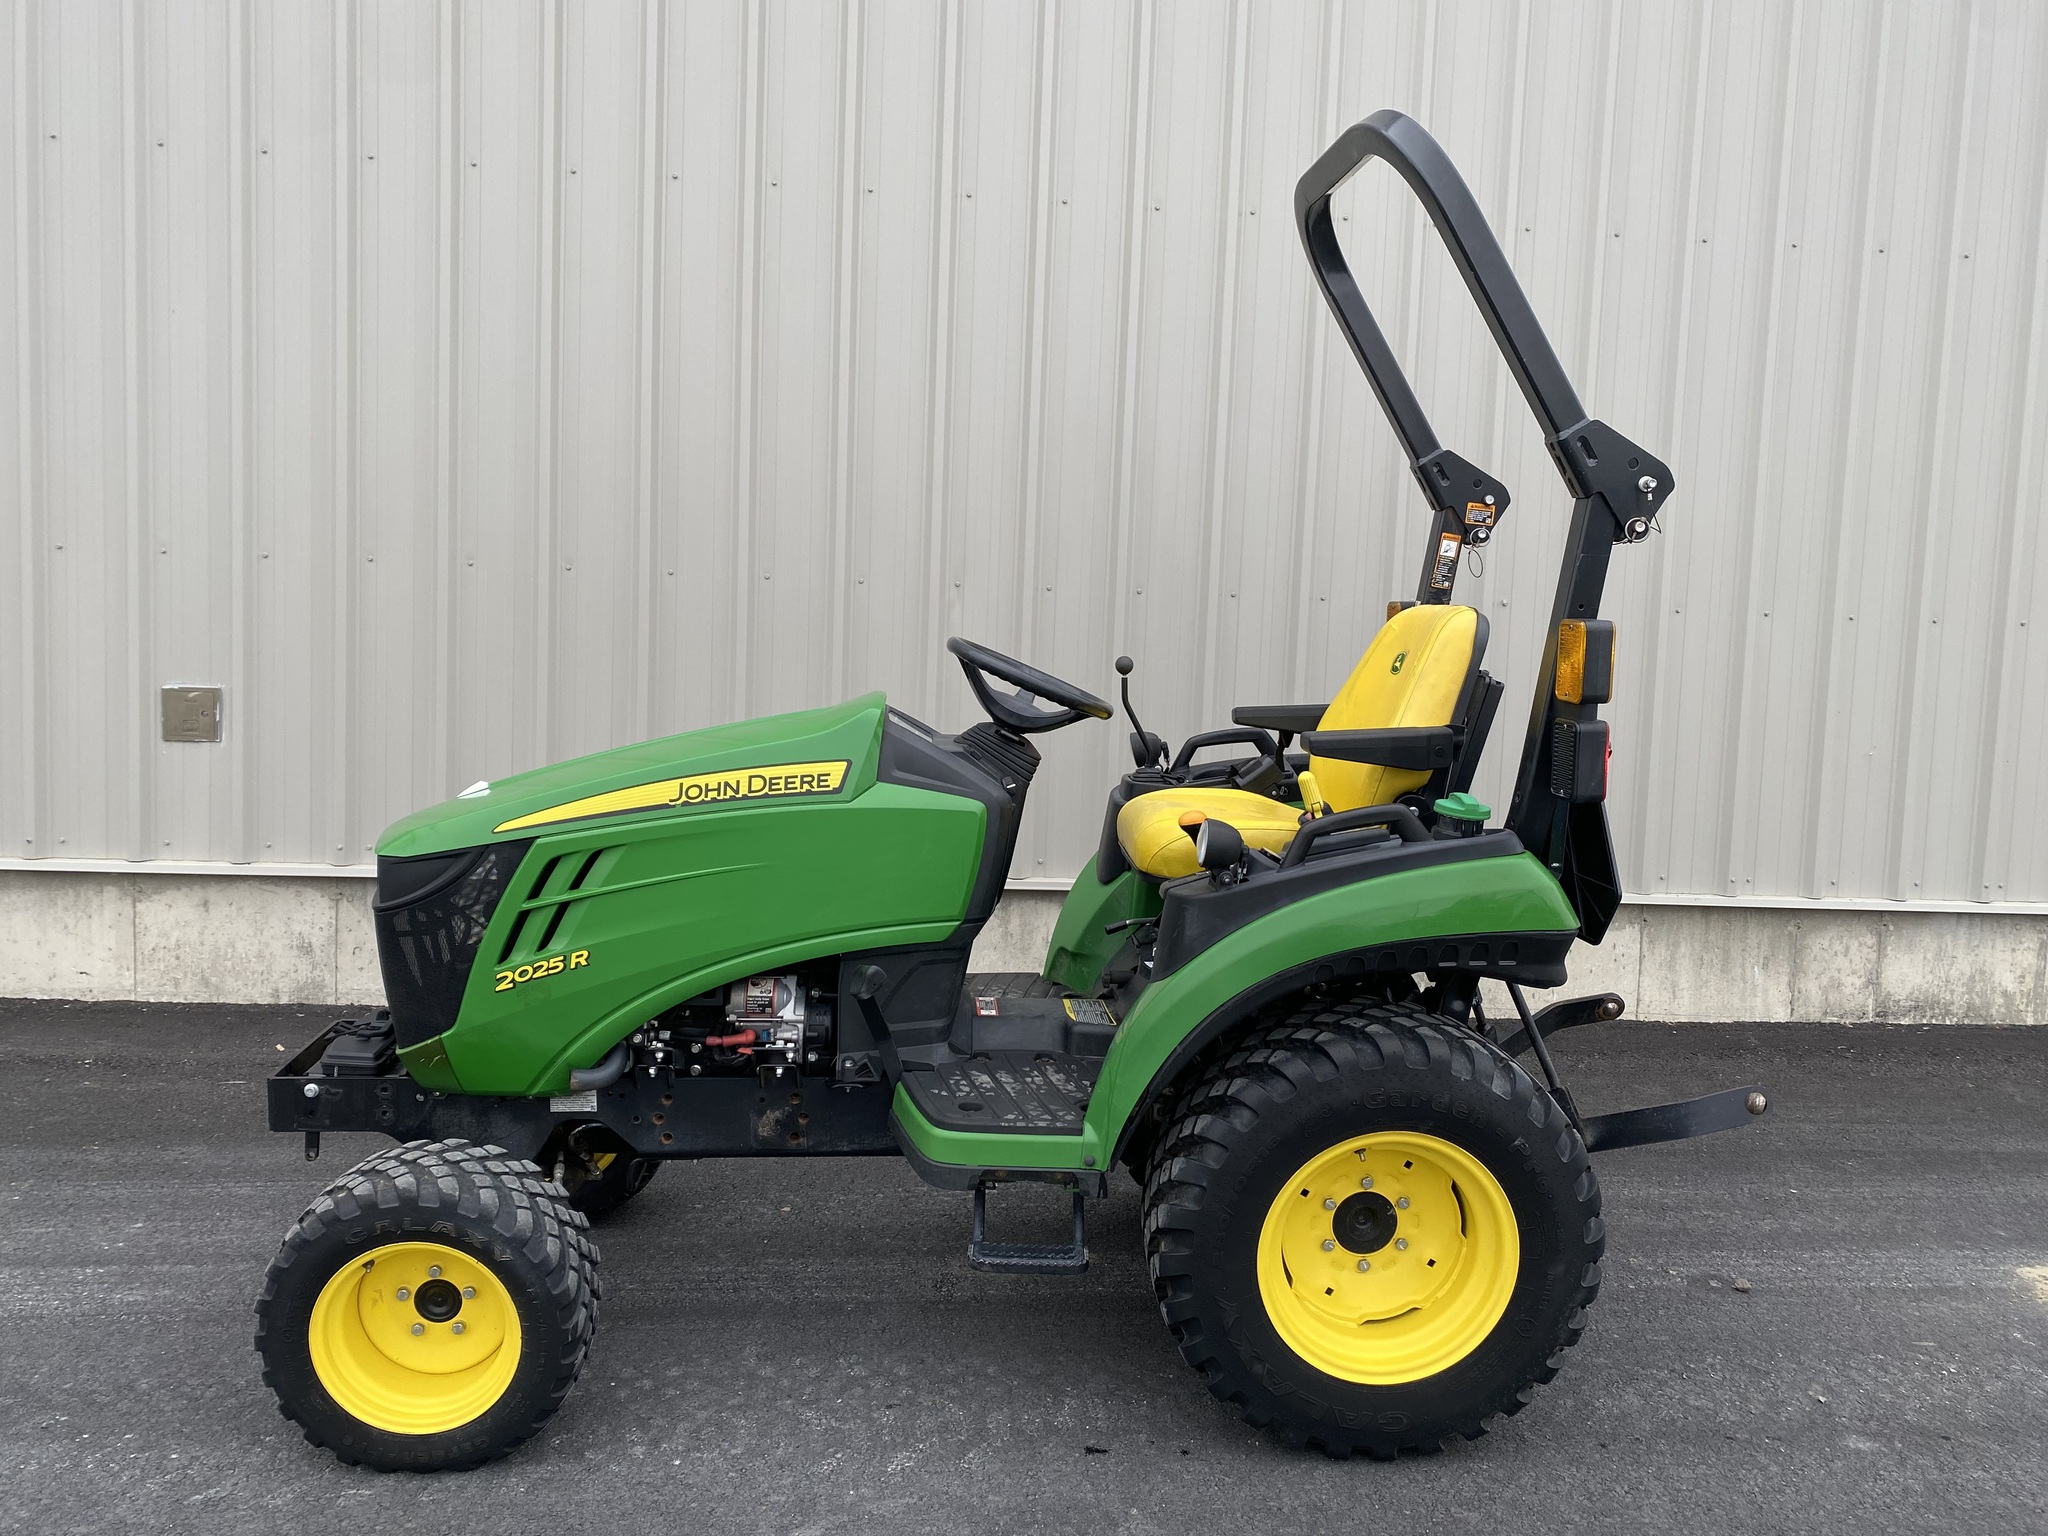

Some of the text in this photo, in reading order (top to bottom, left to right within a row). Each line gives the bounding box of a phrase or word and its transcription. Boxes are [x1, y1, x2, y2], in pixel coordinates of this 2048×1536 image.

[669, 773, 831, 803] JOHN DEERE
[495, 949, 591, 993] 2025 R
[1363, 1087, 1489, 1129] Garden
[344, 1216, 514, 1263] GALAXY
[1214, 1294, 1414, 1432] GALAXY
